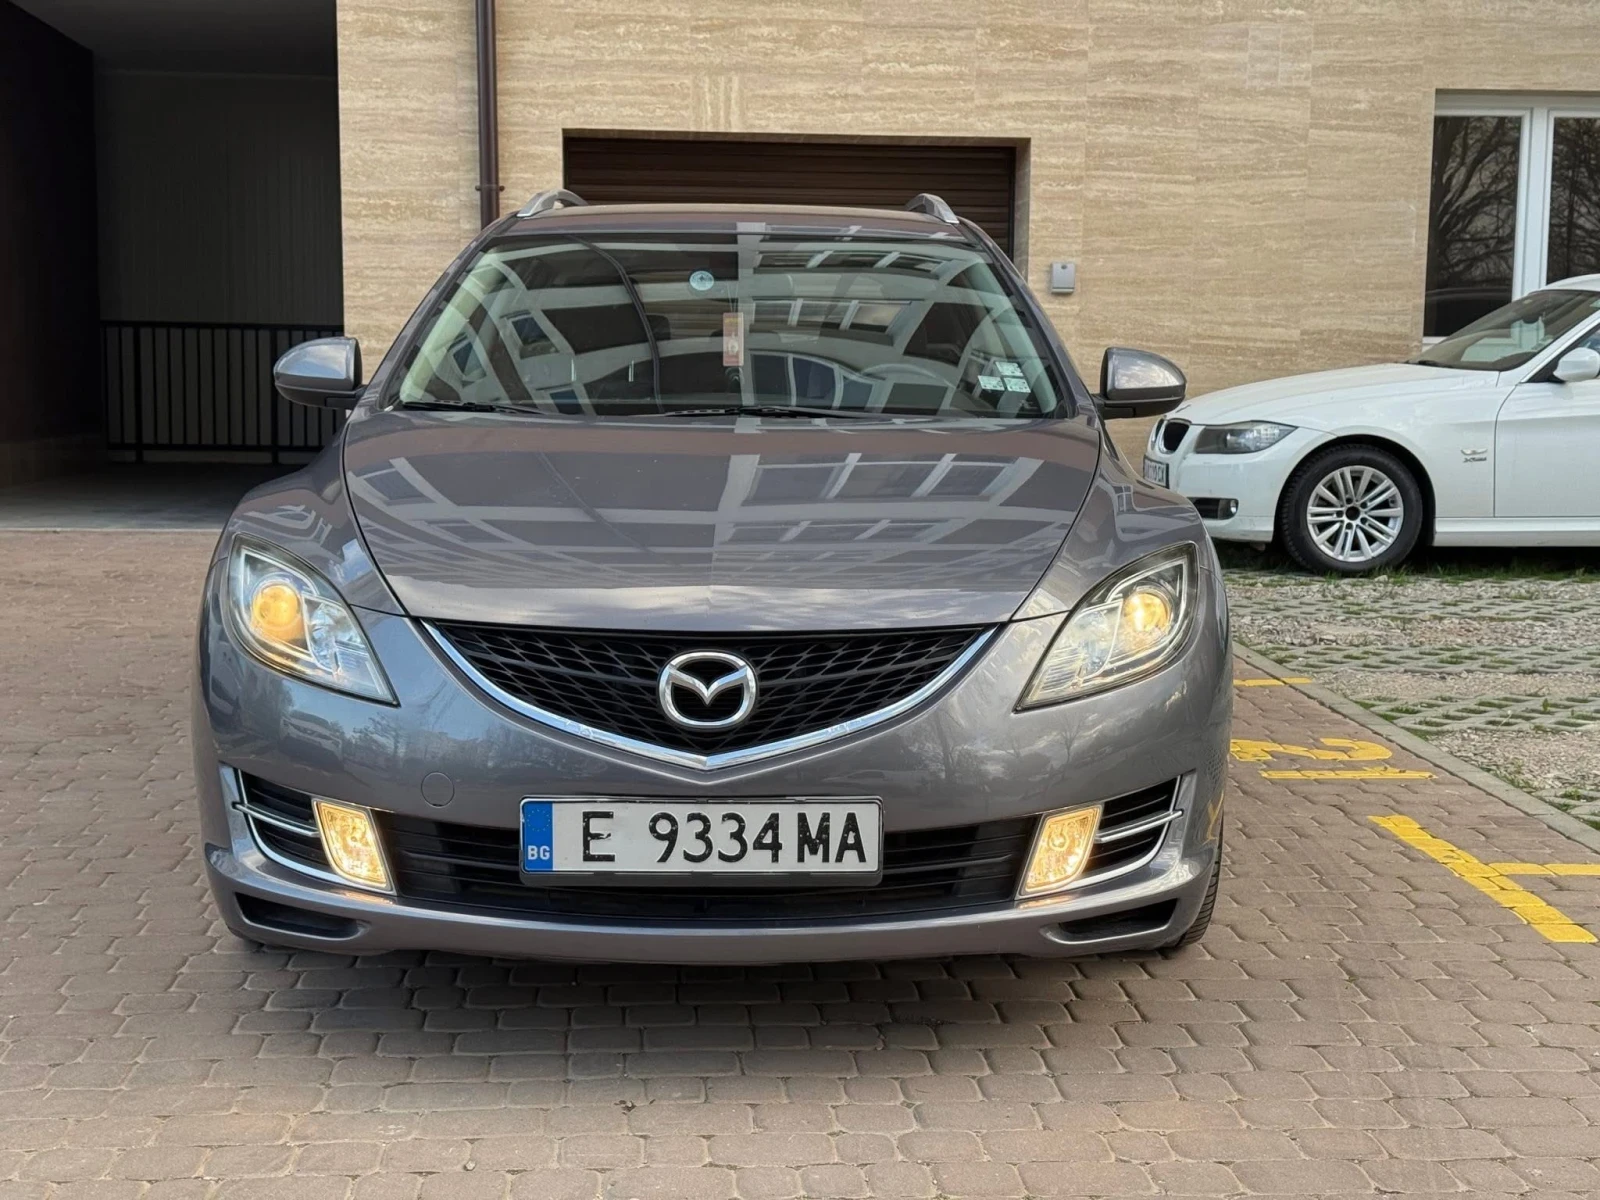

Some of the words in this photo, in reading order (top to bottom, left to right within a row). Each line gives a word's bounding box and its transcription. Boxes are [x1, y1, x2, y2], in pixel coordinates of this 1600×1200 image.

[528, 845, 551, 860] BG
[582, 811, 615, 863] E
[649, 812, 783, 864] 9334
[797, 812, 867, 864] MA
